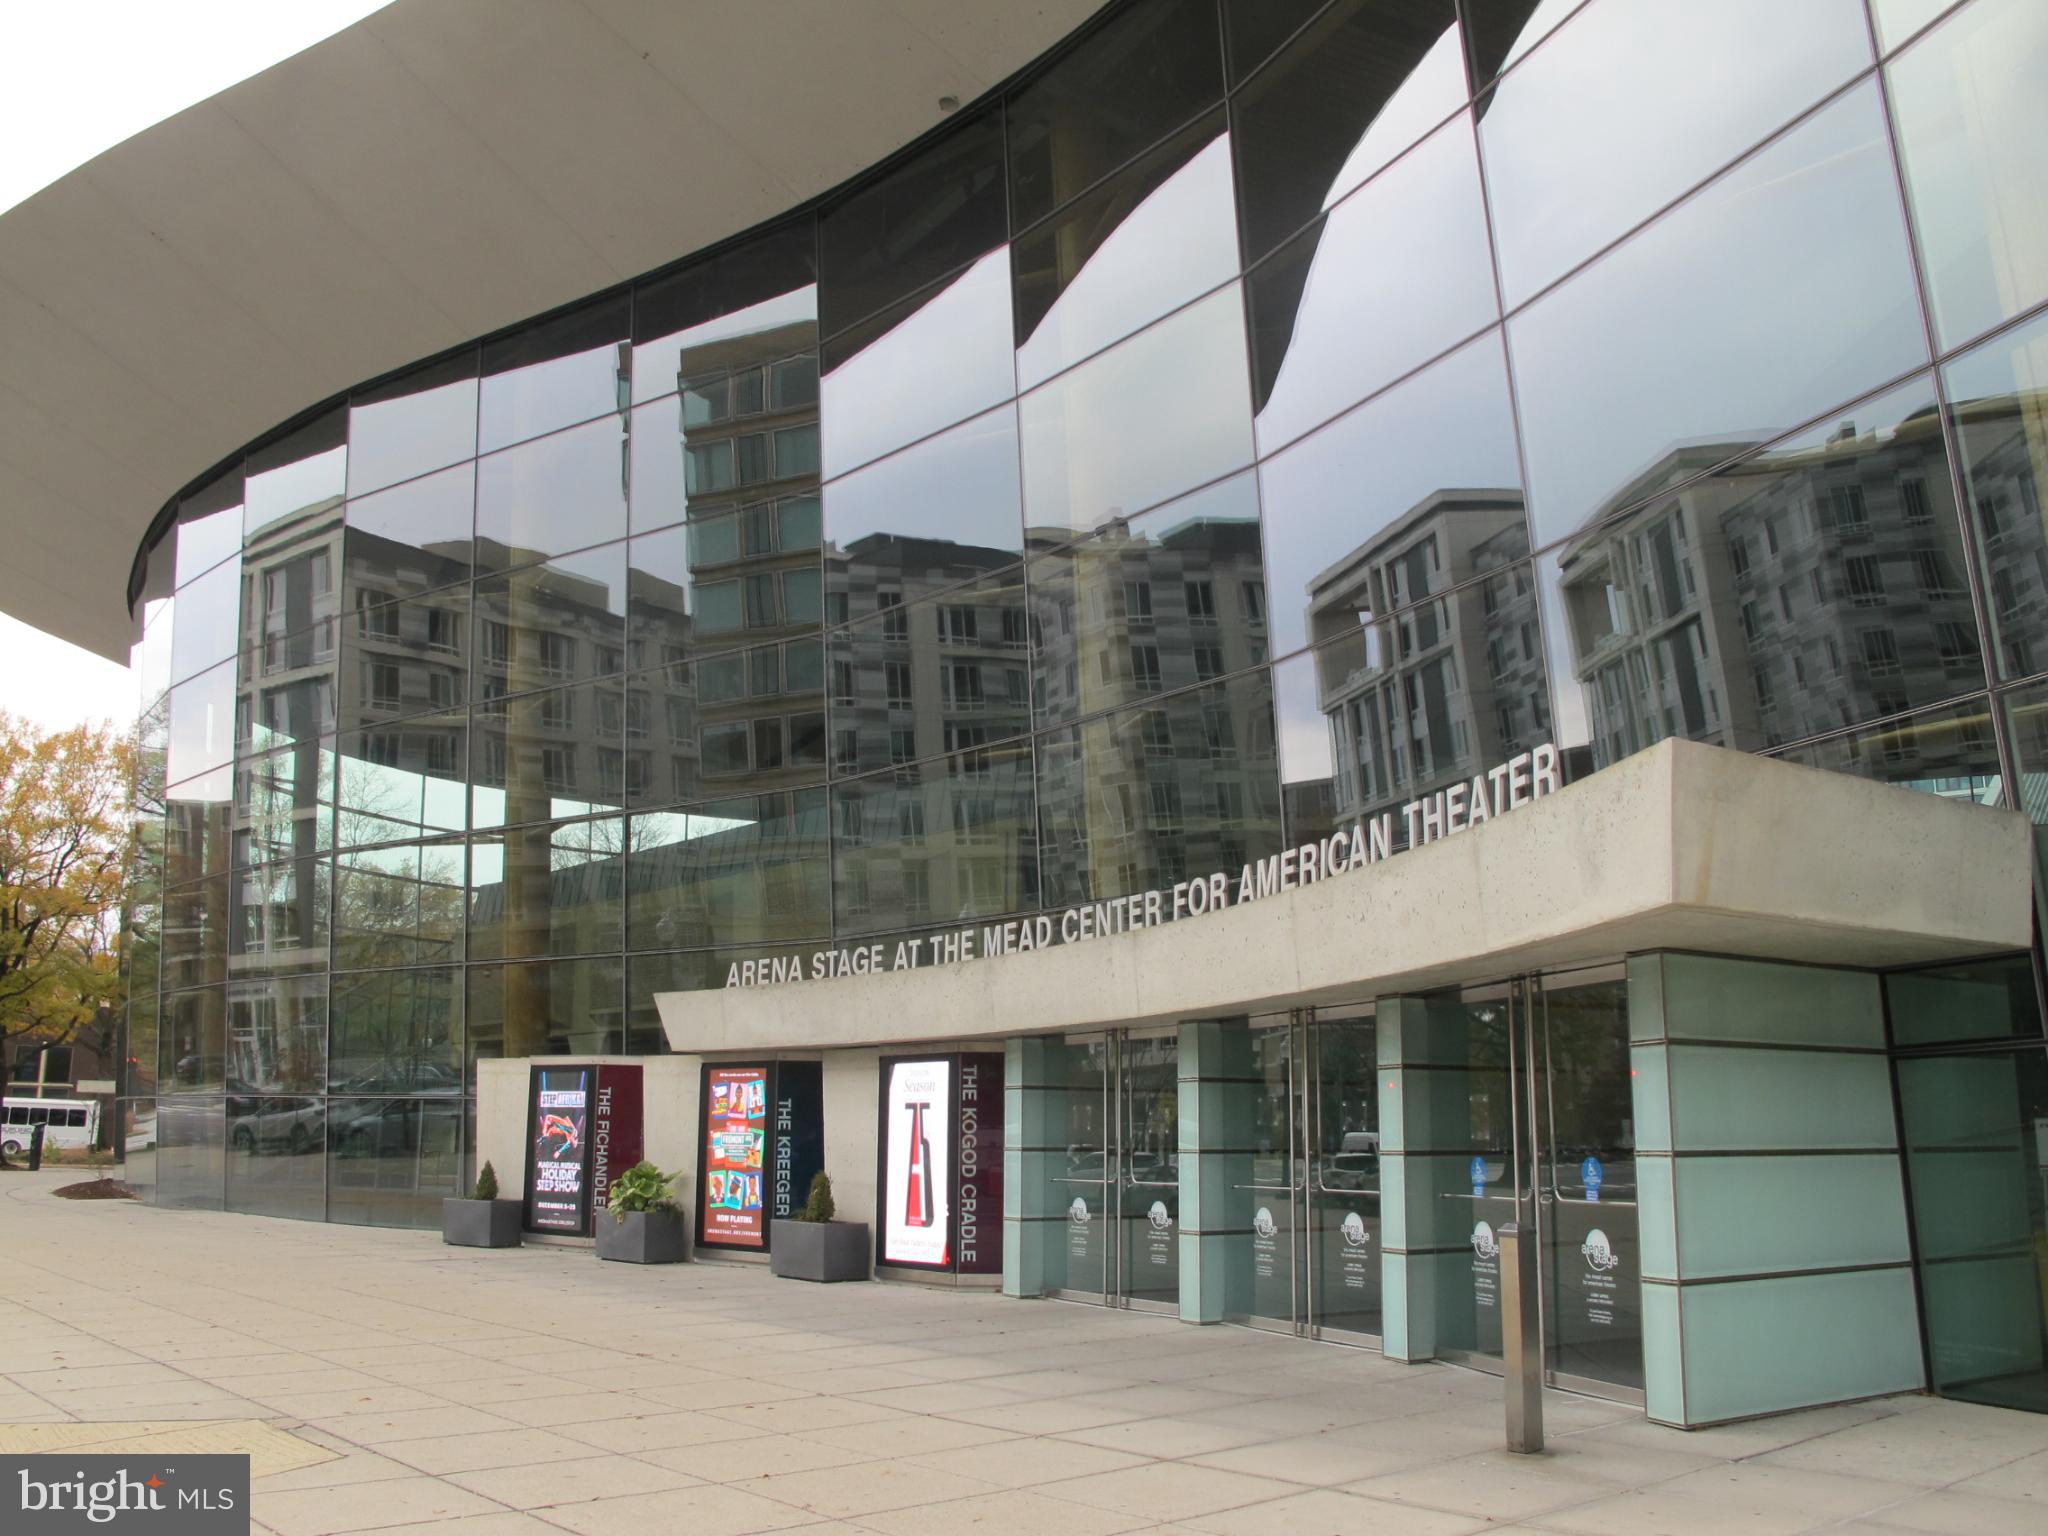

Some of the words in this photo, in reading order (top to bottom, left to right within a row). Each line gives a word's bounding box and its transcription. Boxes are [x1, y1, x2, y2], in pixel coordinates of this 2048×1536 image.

[725, 955, 802, 988] ARENA
[811, 944, 884, 980] STAGE
[893, 939, 922, 971] AT
[930, 930, 974, 965] THE
[984, 915, 1052, 958] MEAD
[1062, 890, 1163, 944] CENTER
[1174, 872, 1228, 921] FOR
[1237, 813, 1392, 904] AMERICAN
[1402, 743, 1558, 850] THEATER
[962, 1065, 977, 1100] THE
[598, 1087, 611, 1115] THE
[777, 1098, 791, 1130] THE
[961, 1108, 977, 1178] KOGOD
[541, 1168, 577, 1180] HOLIDAY
[593, 1121, 610, 1212] FICHANDLE
[776, 1137, 791, 1215] KREEGER
[536, 1180, 554, 1191] STEP
[554, 1181, 580, 1192] SHOW
[716, 1214, 730, 1222] NOW
[730, 1215, 753, 1224] PLAYING
[960, 1184, 977, 1262] CRADLE
